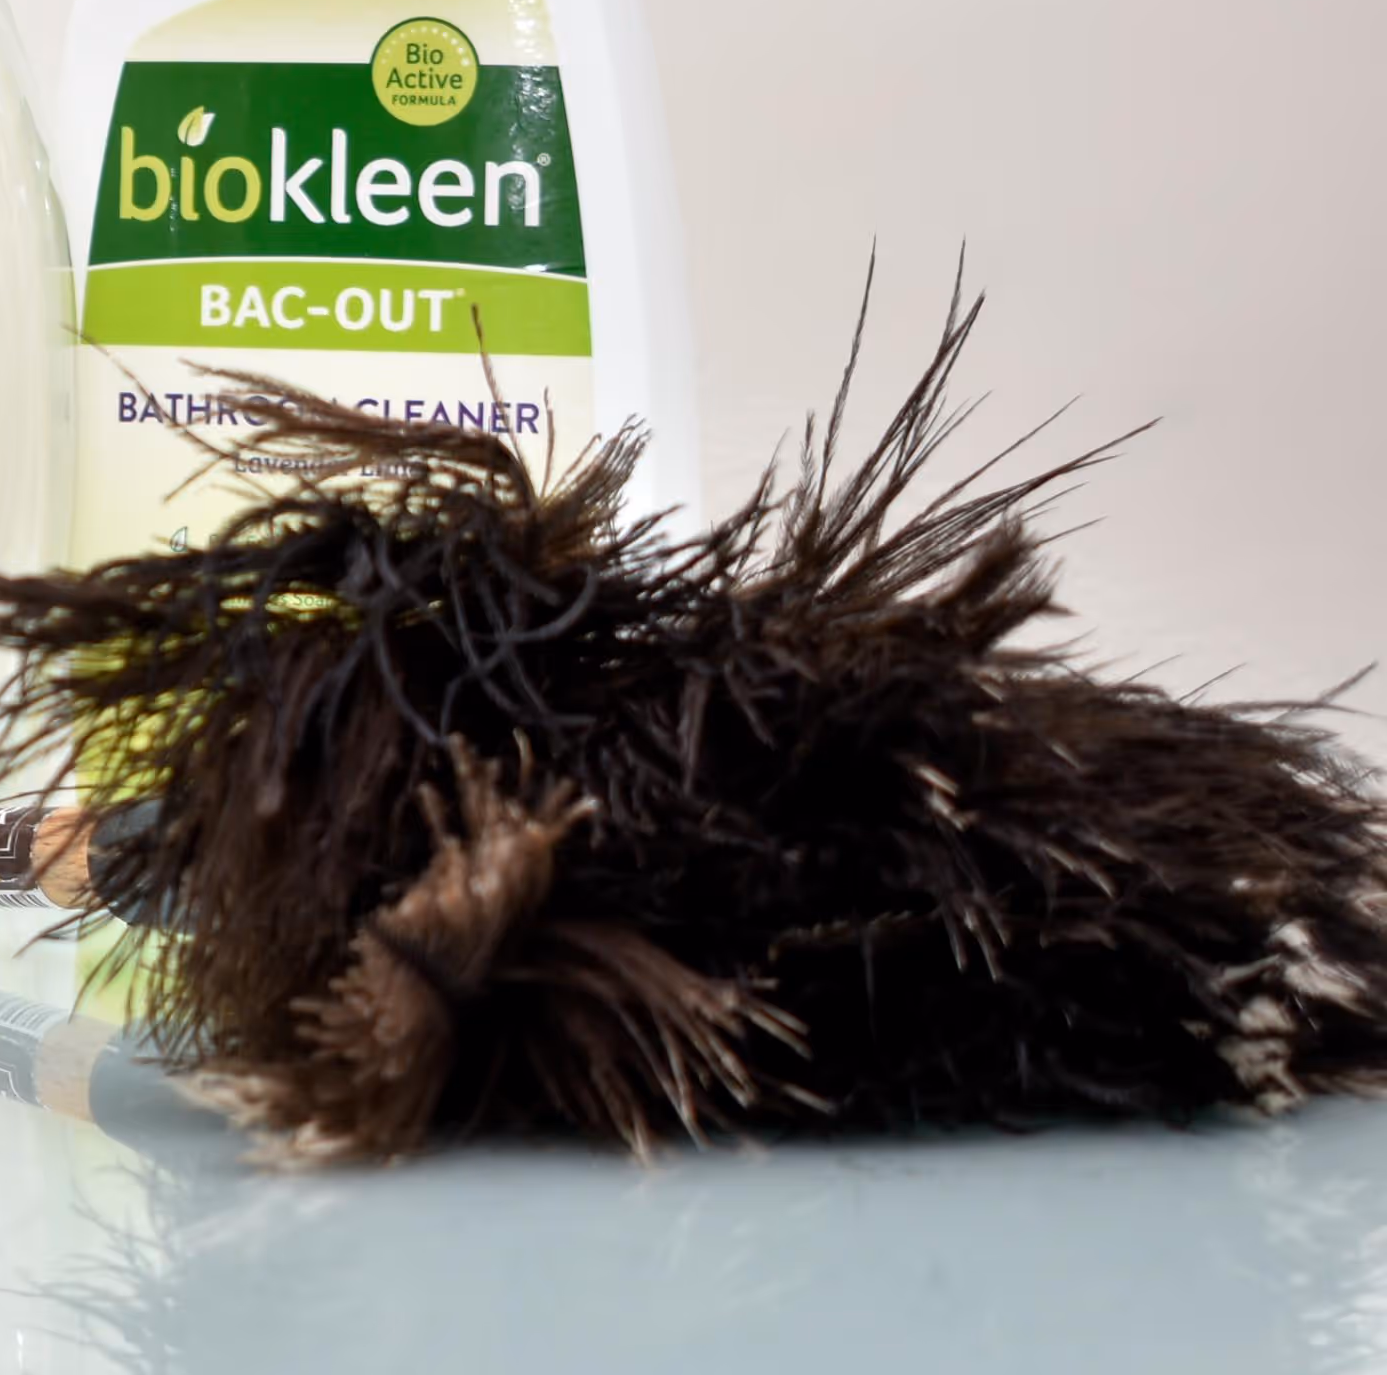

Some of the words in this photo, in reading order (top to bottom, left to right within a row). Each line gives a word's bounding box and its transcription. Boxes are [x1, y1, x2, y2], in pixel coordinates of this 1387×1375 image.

[405, 42, 444, 65] Bio
[386, 68, 464, 90] Active
[391, 94, 456, 106] FORMULA
[119, 124, 541, 227] biokleen
[200, 283, 455, 333] BAC-OUT
